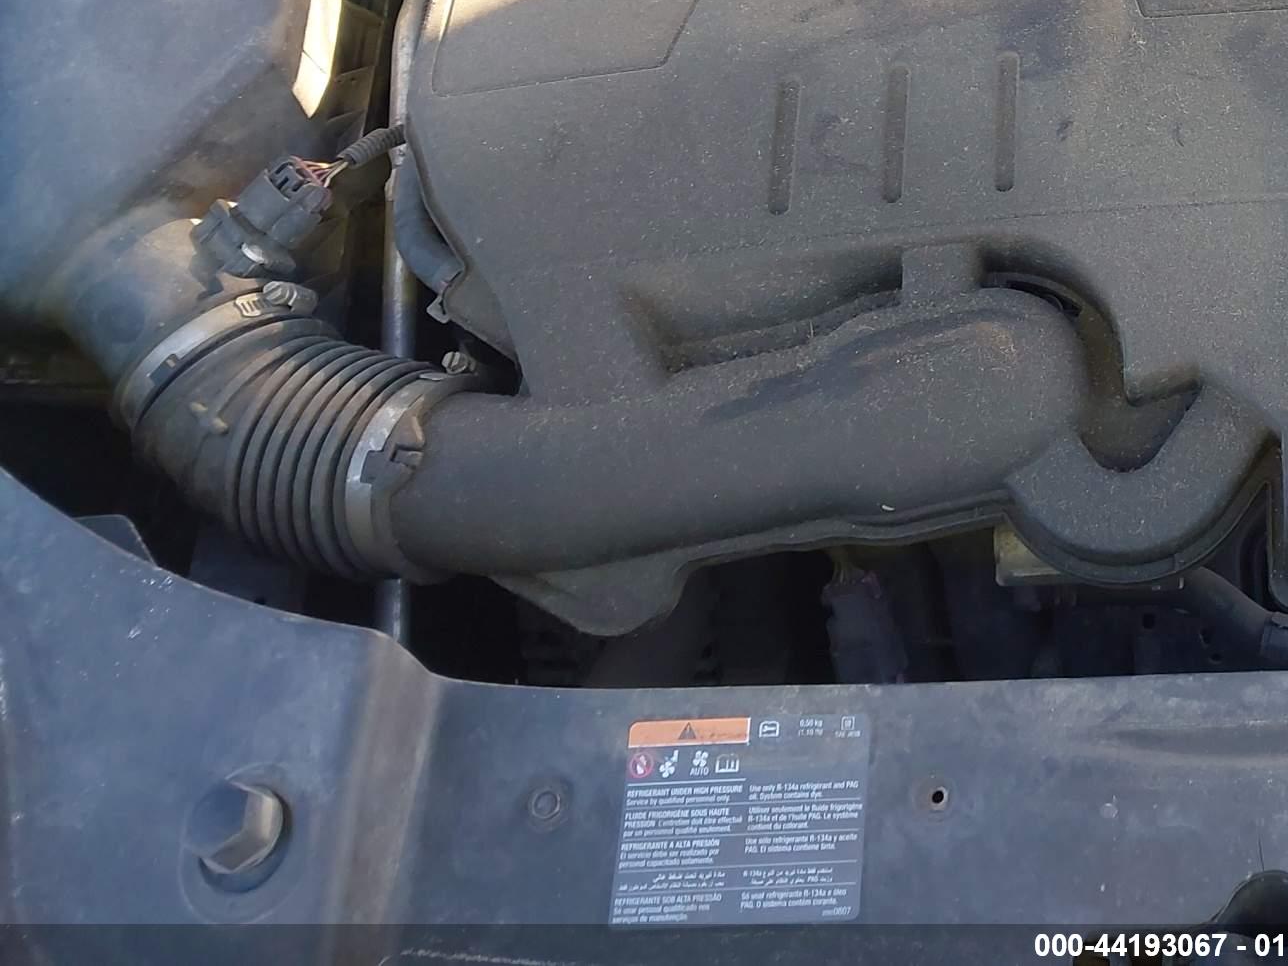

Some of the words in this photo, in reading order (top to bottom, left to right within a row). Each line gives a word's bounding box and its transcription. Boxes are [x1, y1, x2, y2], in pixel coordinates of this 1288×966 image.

[690, 767, 709, 776] AUTO
[627, 788, 669, 797] REFRIGERANT
[671, 787, 692, 795] UNDER
[710, 785, 742, 794] PRESSURE
[799, 782, 832, 791] refrigerant
[650, 798, 657, 806] by
[659, 797, 684, 806] qualified
[625, 812, 647, 820] FLUIDE
[709, 808, 729, 816] HAUTE
[621, 842, 668, 850] REFRIGERANTE
[614, 897, 661, 905] REFRIGERANTE
[676, 895, 690, 903] ALTA
